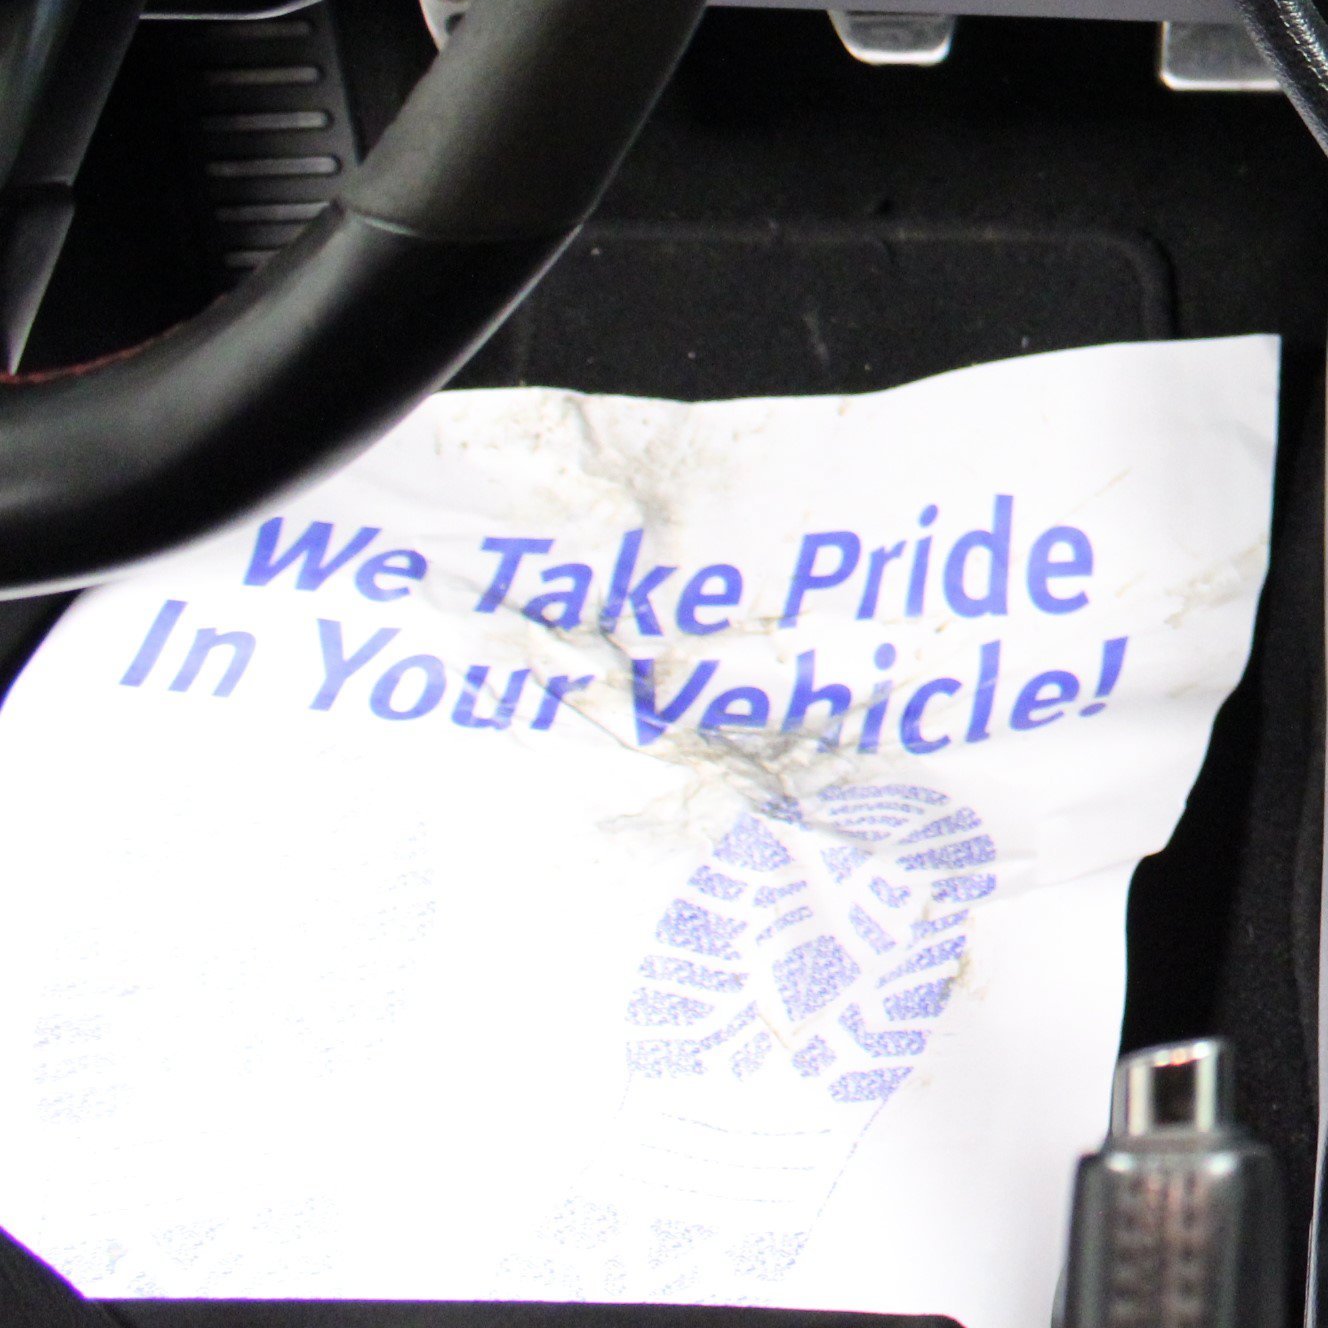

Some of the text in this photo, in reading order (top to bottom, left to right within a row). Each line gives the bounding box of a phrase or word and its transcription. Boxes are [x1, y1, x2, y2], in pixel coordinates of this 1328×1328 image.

[242, 494, 1095, 637] We Take Pride
[119, 599, 1129, 756] In Your Vehicle!
